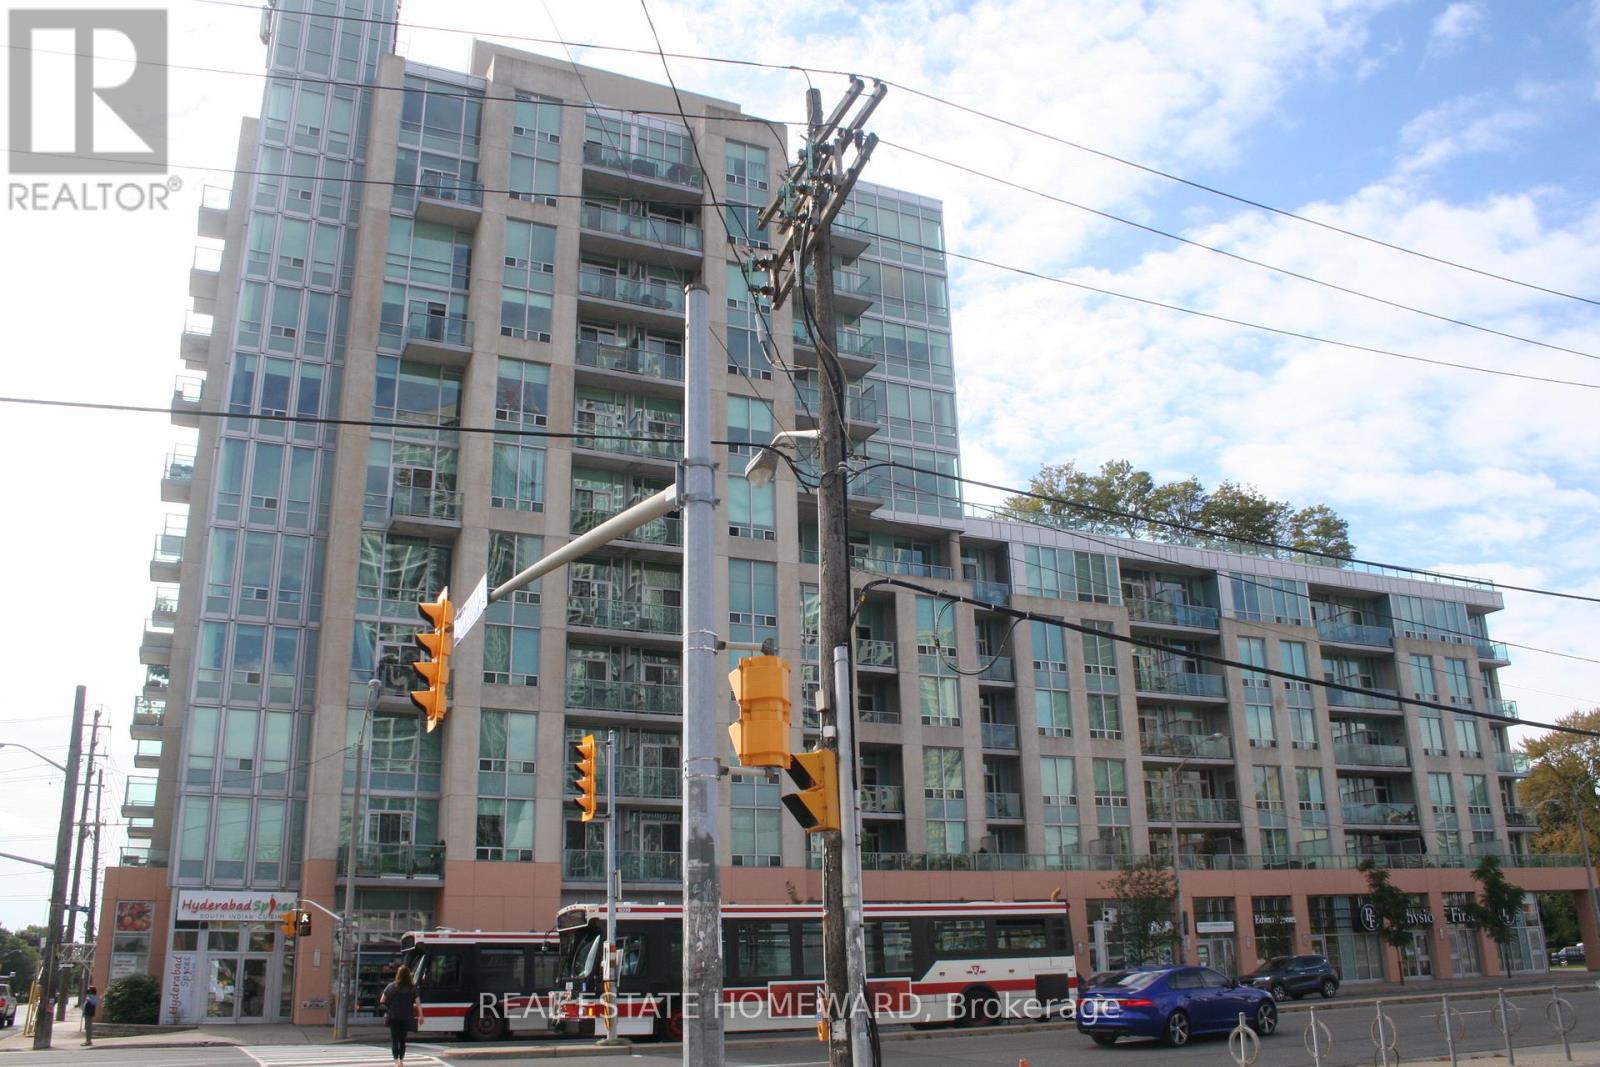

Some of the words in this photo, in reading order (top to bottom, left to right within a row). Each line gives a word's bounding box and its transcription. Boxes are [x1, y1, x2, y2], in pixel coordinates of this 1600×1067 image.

[182, 898, 252, 913] Hyderabad
[1406, 908, 1434, 925] hysio
[168, 956, 183, 1015] Hyderabad
